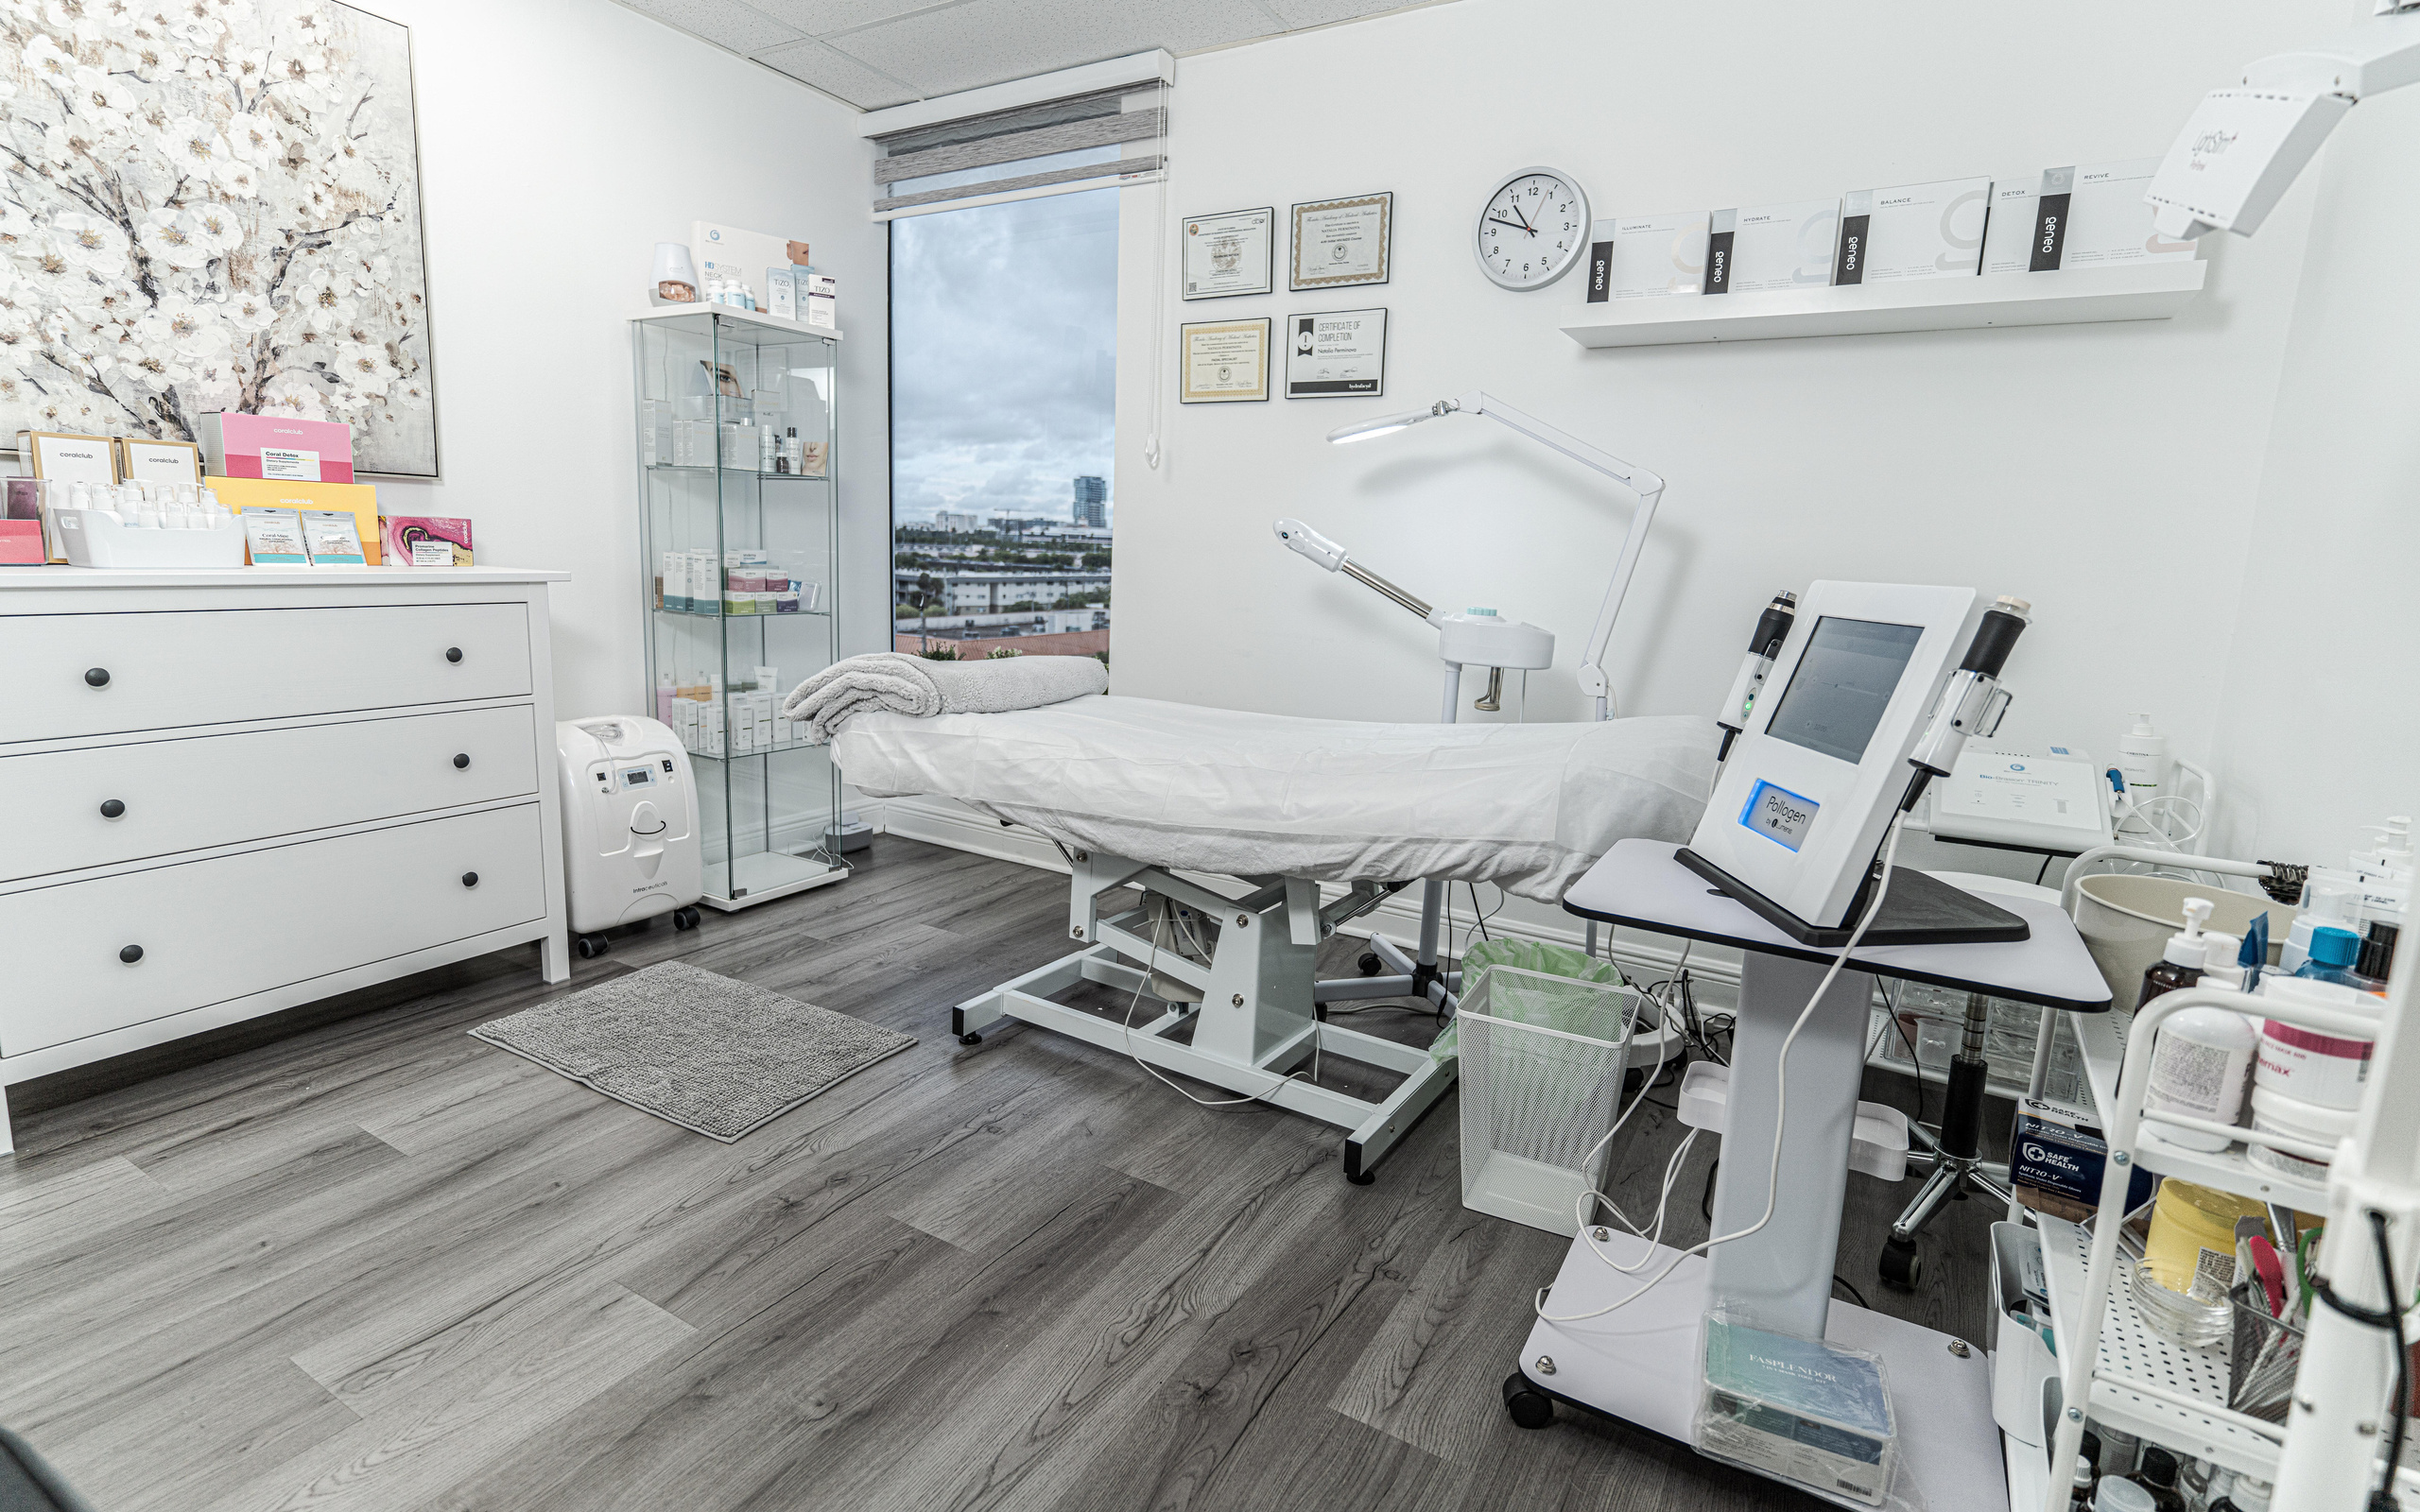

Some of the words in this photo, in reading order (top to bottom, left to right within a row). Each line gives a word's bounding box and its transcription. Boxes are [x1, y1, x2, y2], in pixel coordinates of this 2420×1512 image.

[1528, 187, 1538, 196] 12
[1549, 191, 1553, 199] 1
[1560, 204, 1566, 212] 2
[1497, 209, 1507, 218] 10
[1564, 222, 1569, 231] 3
[1491, 228, 1496, 236] 9
[2042, 216, 2057, 253] geneo
[1493, 246, 1499, 254] 8
[1846, 236, 1858, 270] geneo
[1523, 263, 1529, 271] 6
[1713, 251, 1724, 283] geneo
[1595, 260, 1605, 290] geneo
[1318, 322, 1352, 332] CERTIFICATE
[1353, 321, 1361, 330] OF
[1318, 332, 1352, 342] COMPLETION
[1766, 796, 1806, 824] Pollogen
[2050, 1110, 2088, 1122] HEALTH
[2051, 1107, 2076, 1115] SAFE
[2046, 1151, 2070, 1163] SAFE
[2044, 1158, 2079, 1172] HEALTH
[1749, 1354, 1837, 1383] FASPLENDOR
